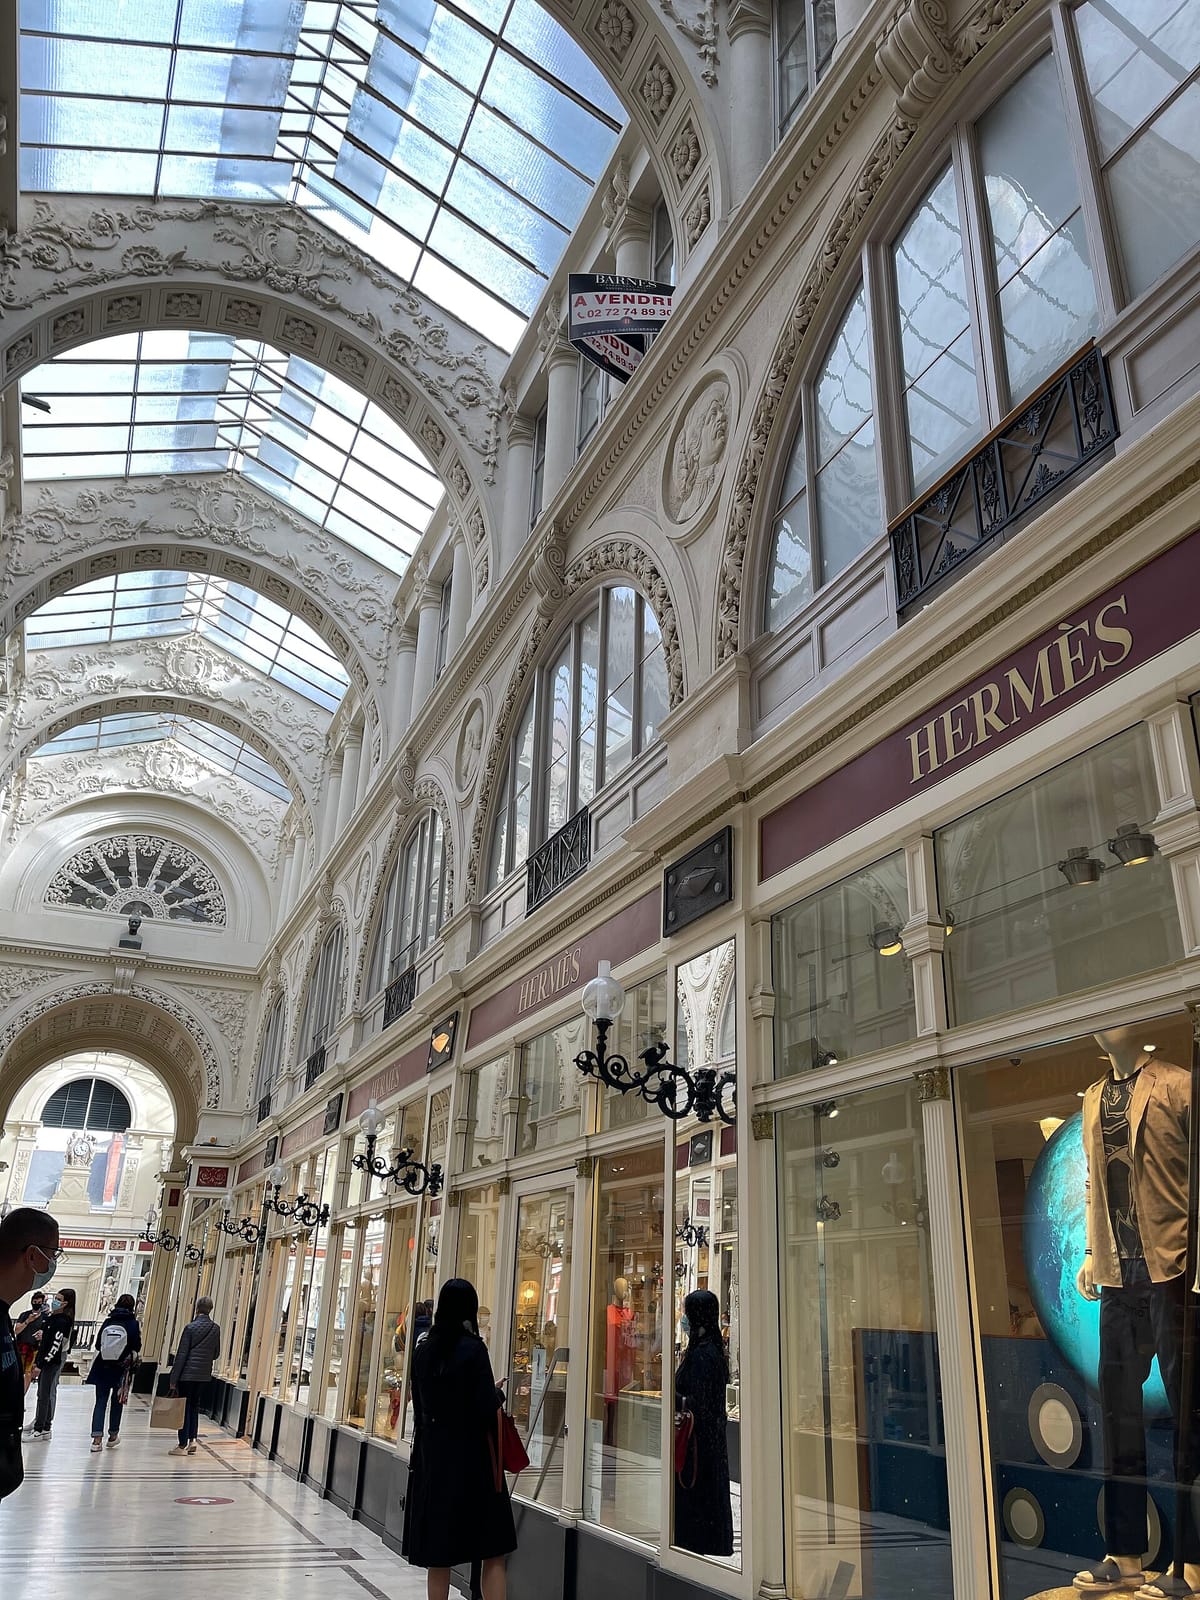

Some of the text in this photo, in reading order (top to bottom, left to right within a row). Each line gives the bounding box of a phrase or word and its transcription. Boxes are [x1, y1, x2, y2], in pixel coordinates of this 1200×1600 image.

[595, 274, 657, 288] BARNES
[574, 295, 587, 307] A
[587, 309, 602, 318] 02
[605, 308, 620, 316] 72
[623, 308, 637, 316] 74
[641, 308, 656, 316] 89
[600, 335, 629, 356] NDU
[906, 594, 1134, 785] HERMÈS
[517, 948, 581, 1015] HERMÈS
[63, 1239, 104, 1250] L'HORLOGE
